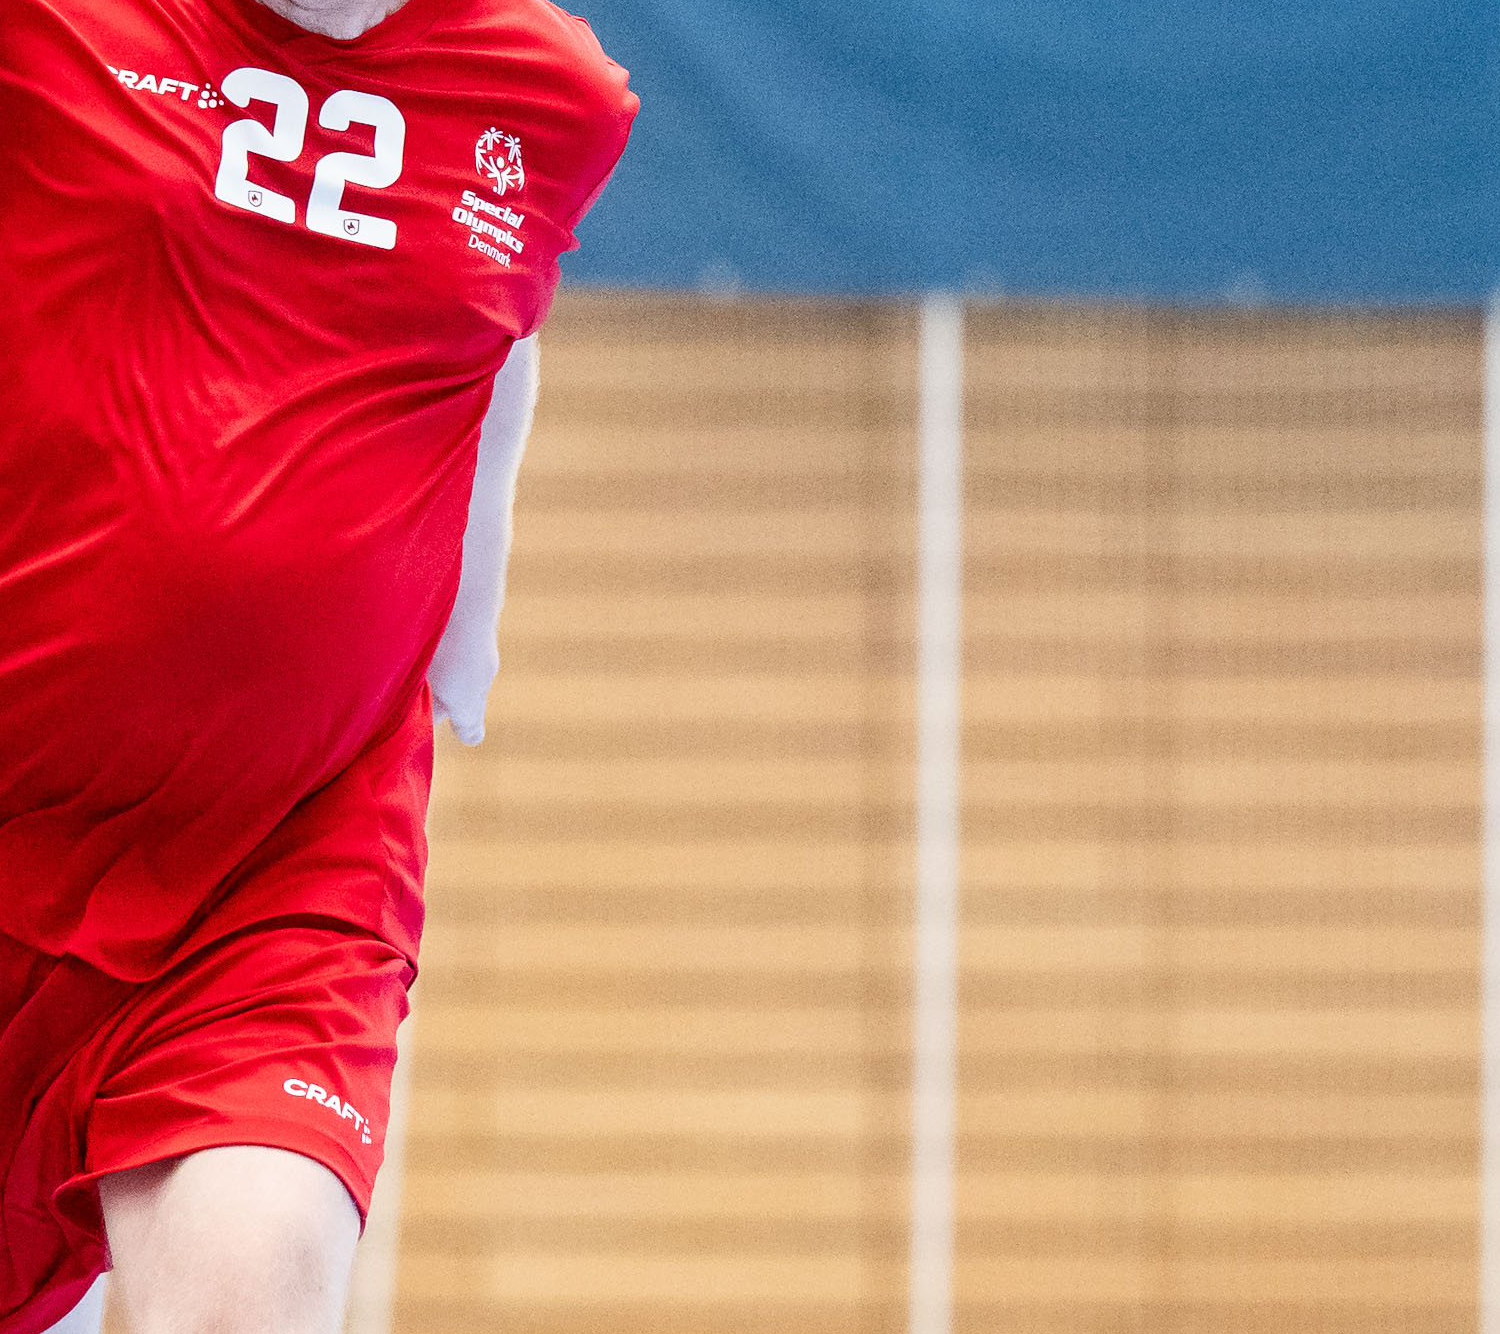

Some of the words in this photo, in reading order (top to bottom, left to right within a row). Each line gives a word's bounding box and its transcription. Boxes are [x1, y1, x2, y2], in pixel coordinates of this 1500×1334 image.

[214, 67, 406, 250] 22
[452, 206, 524, 254] Olympics
[461, 190, 525, 229] Special
[468, 234, 511, 269] Denmark
[283, 1078, 364, 1131] CRAFT
